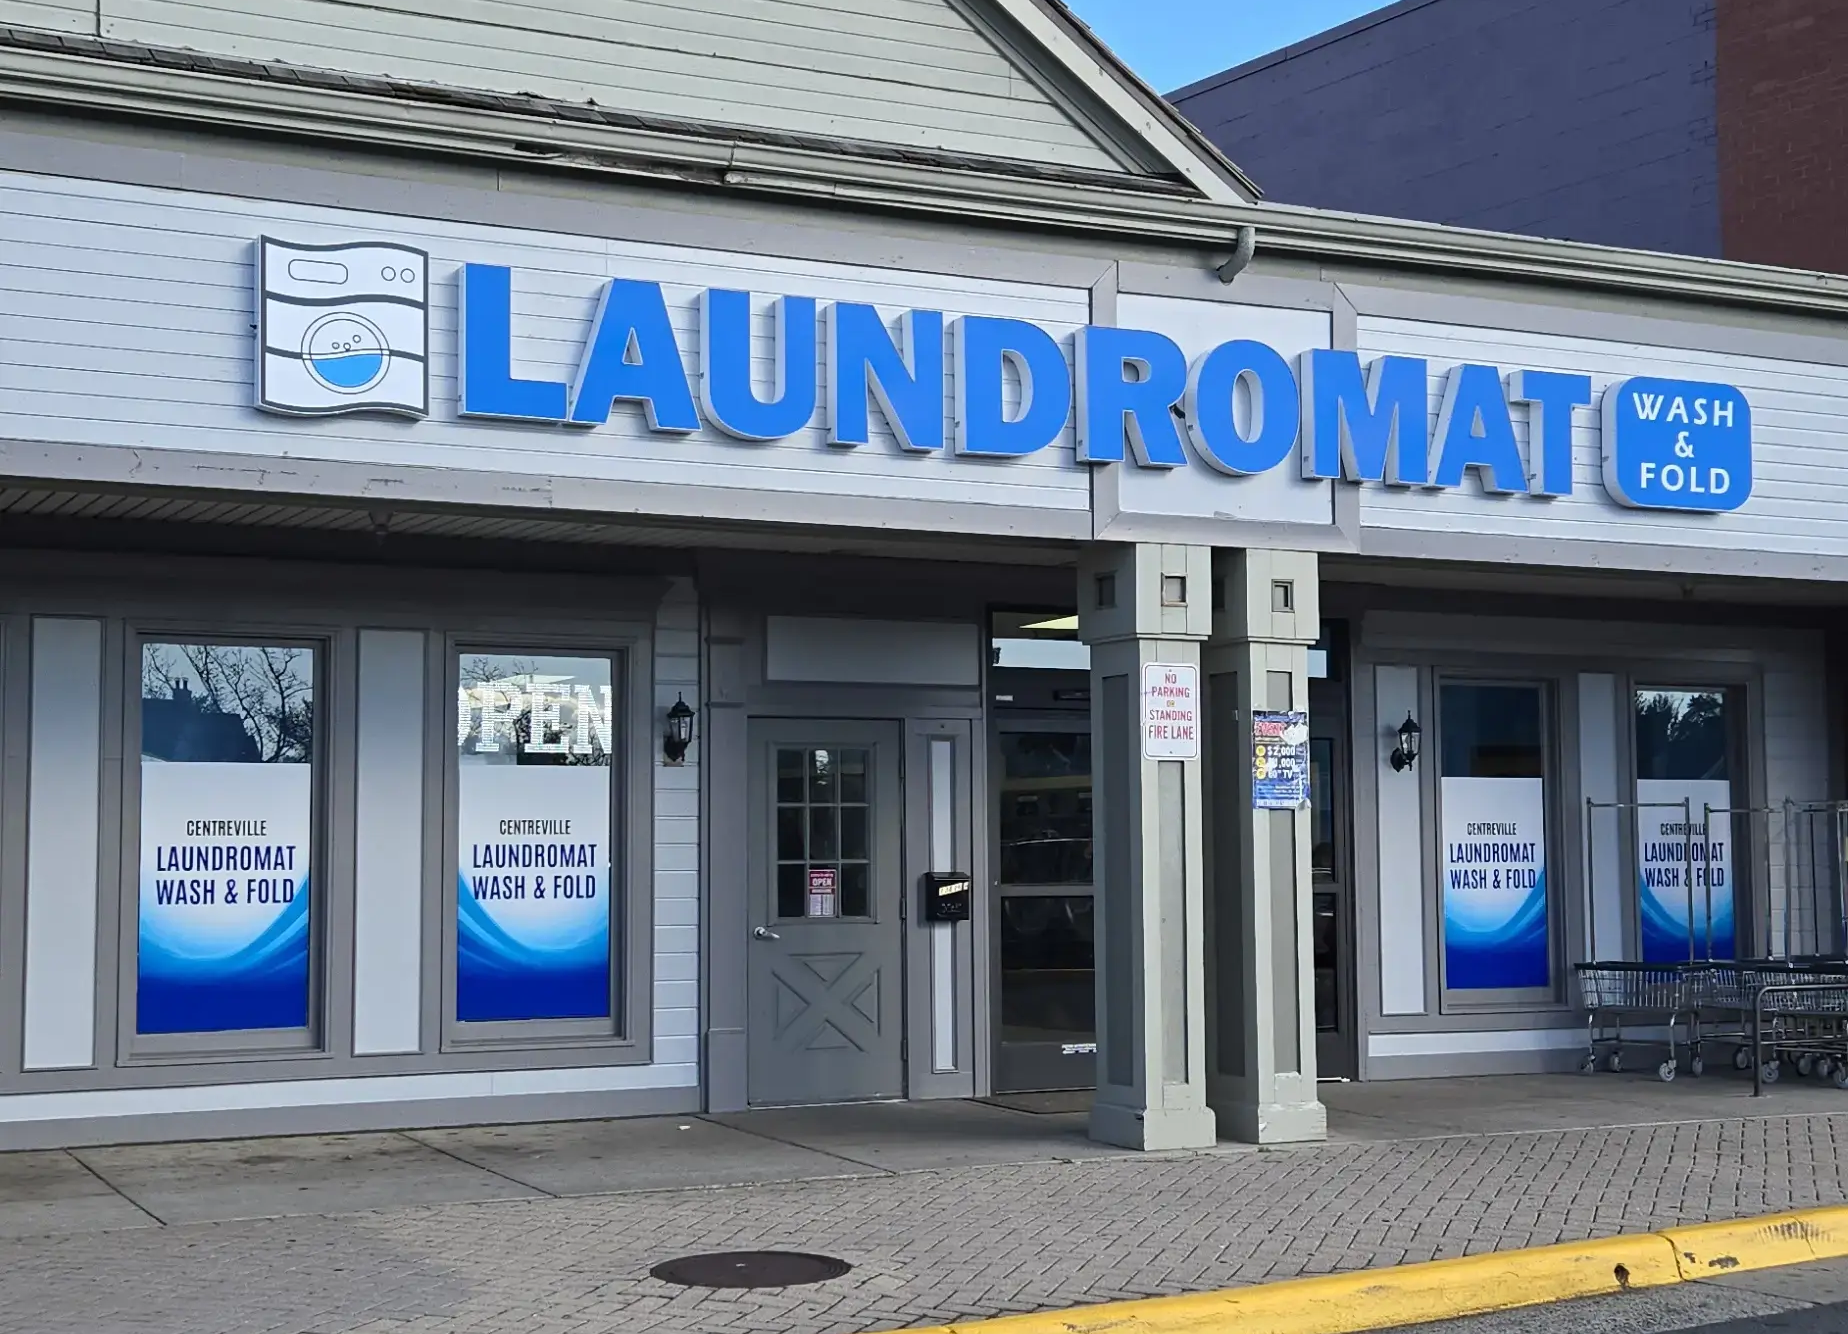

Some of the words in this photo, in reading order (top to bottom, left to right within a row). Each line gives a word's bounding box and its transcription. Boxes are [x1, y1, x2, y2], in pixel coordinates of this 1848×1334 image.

[460, 263, 1591, 497] LAUNDROMAT
[1632, 392, 1734, 428] WASH
[1674, 431, 1695, 458] &
[1640, 462, 1731, 494] FOLD
[1165, 673, 1177, 684] NO
[1151, 686, 1190, 698] PARKING
[1149, 709, 1193, 722] STANDING
[1148, 725, 1168, 739] FIRE
[1171, 726, 1194, 740] LANE
[186, 820, 267, 836] CENTREVILLE
[500, 819, 571, 835] CENTREVILLE
[1467, 822, 1517, 835] CENTREVILLE
[157, 845, 296, 872] LAUNDROMAT
[473, 844, 597, 868] LAUNDROMAT
[1450, 842, 1535, 863] LAUNDROMAT
[472, 875, 525, 900] WASH
[534, 875, 546, 899] &
[554, 875, 596, 899] FOLD
[812, 877, 832, 886] OPEN
[1450, 869, 1487, 889] WASH
[1492, 869, 1501, 889] &
[1506, 868, 1536, 889] FOLD
[1644, 867, 1679, 887] WASH
[156, 879, 215, 905] WASH
[224, 878, 238, 904] &
[247, 878, 294, 903] FOLD
